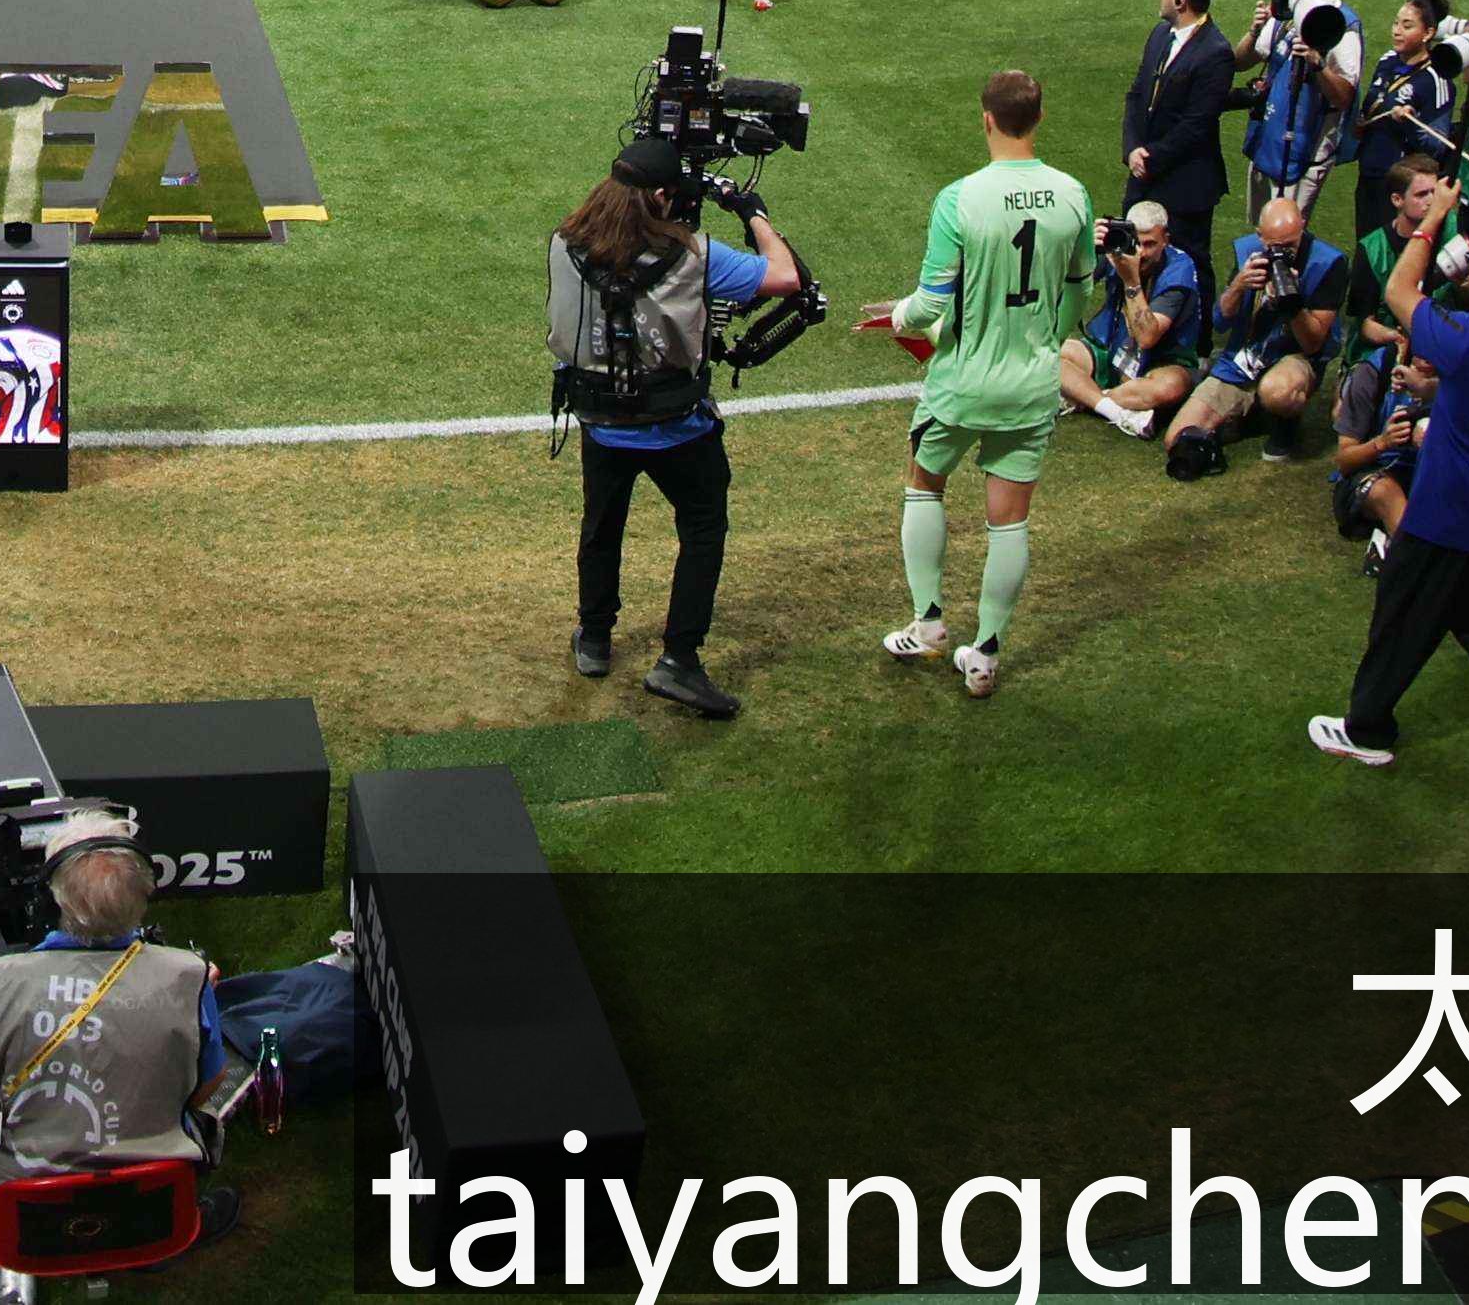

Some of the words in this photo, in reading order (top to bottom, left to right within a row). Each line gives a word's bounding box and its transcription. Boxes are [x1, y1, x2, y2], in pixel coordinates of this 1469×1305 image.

[1004, 190, 1055, 213] NEUER
[1006, 219, 1040, 308] 1
[29, 1060, 106, 1094] WORLD
[102, 1100, 121, 1147] CUP
